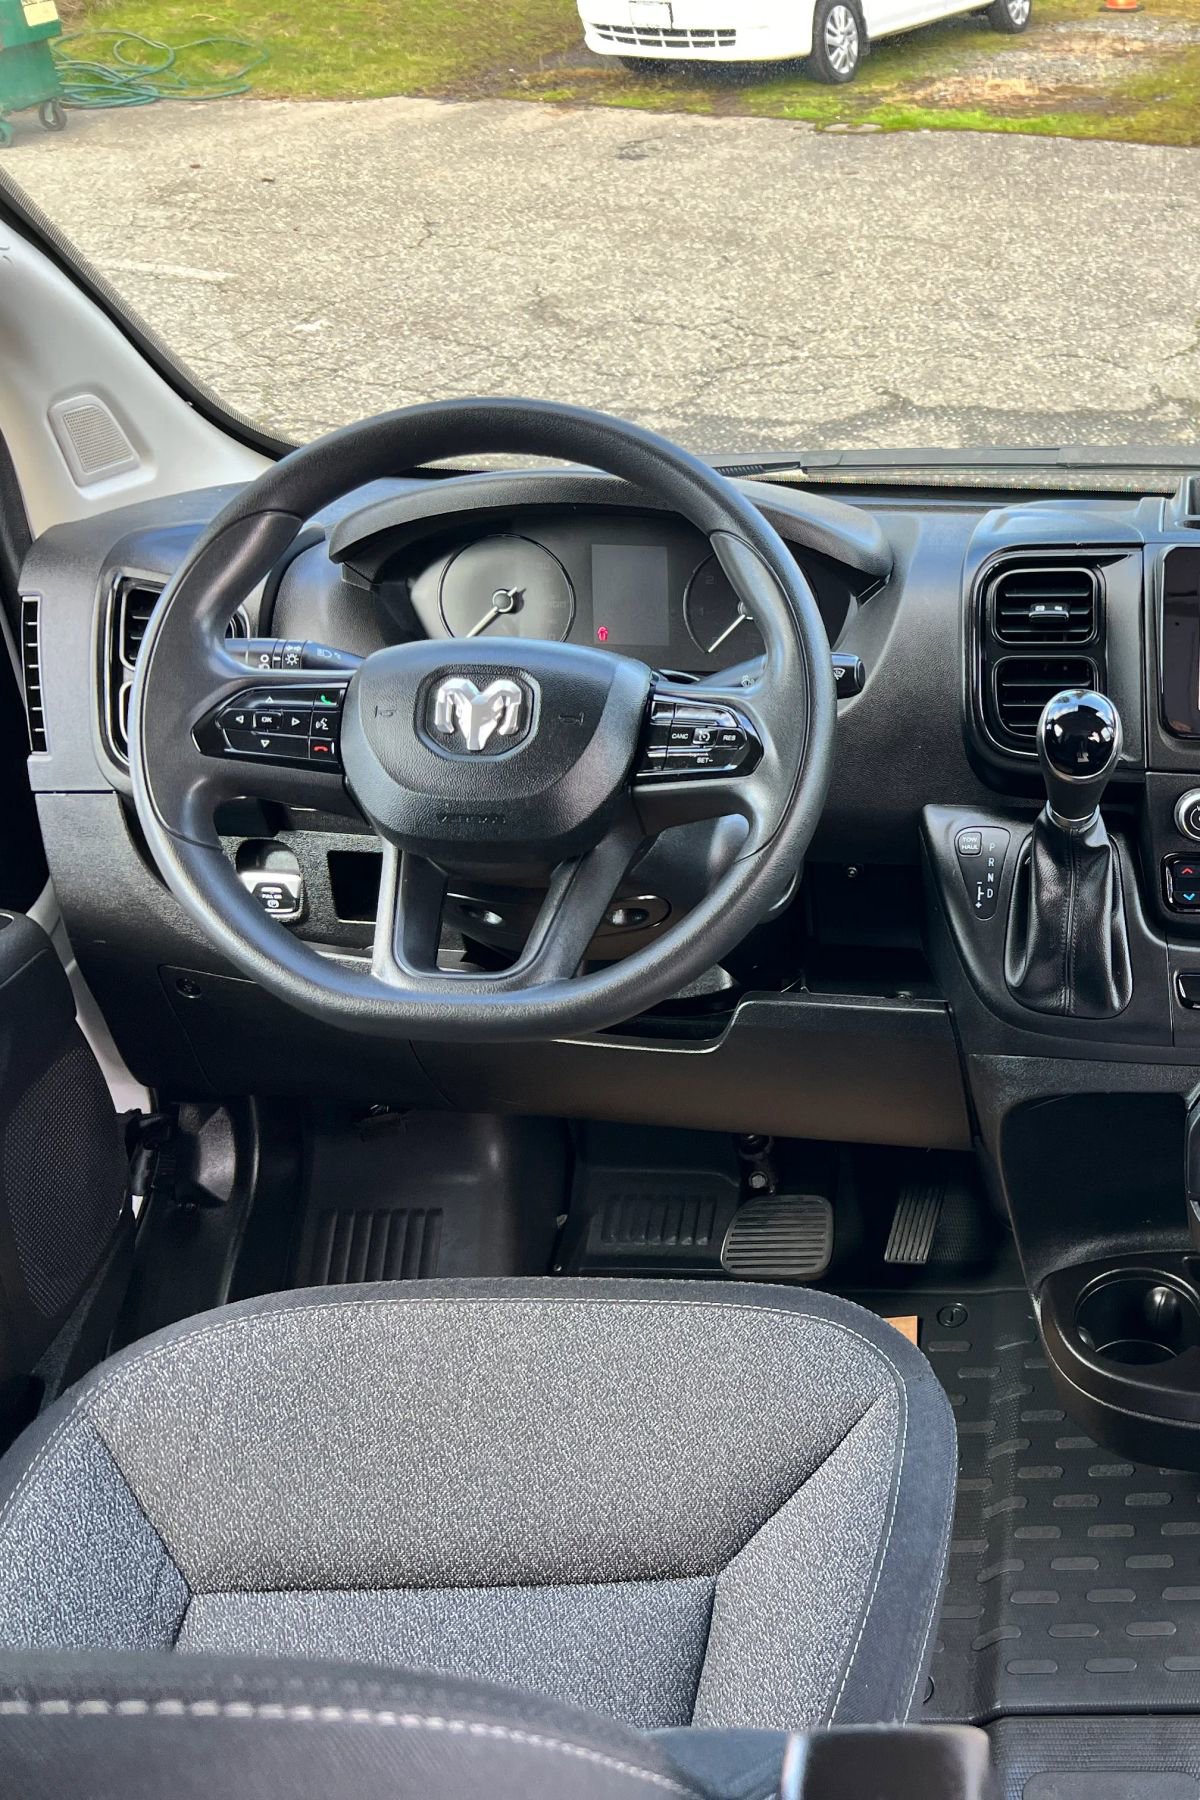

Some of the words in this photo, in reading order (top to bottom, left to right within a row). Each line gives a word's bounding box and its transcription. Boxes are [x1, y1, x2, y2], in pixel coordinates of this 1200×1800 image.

[989, 843, 996, 852] P
[988, 858, 995, 867] R
[987, 873, 994, 882] N
[986, 889, 994, 898] D
